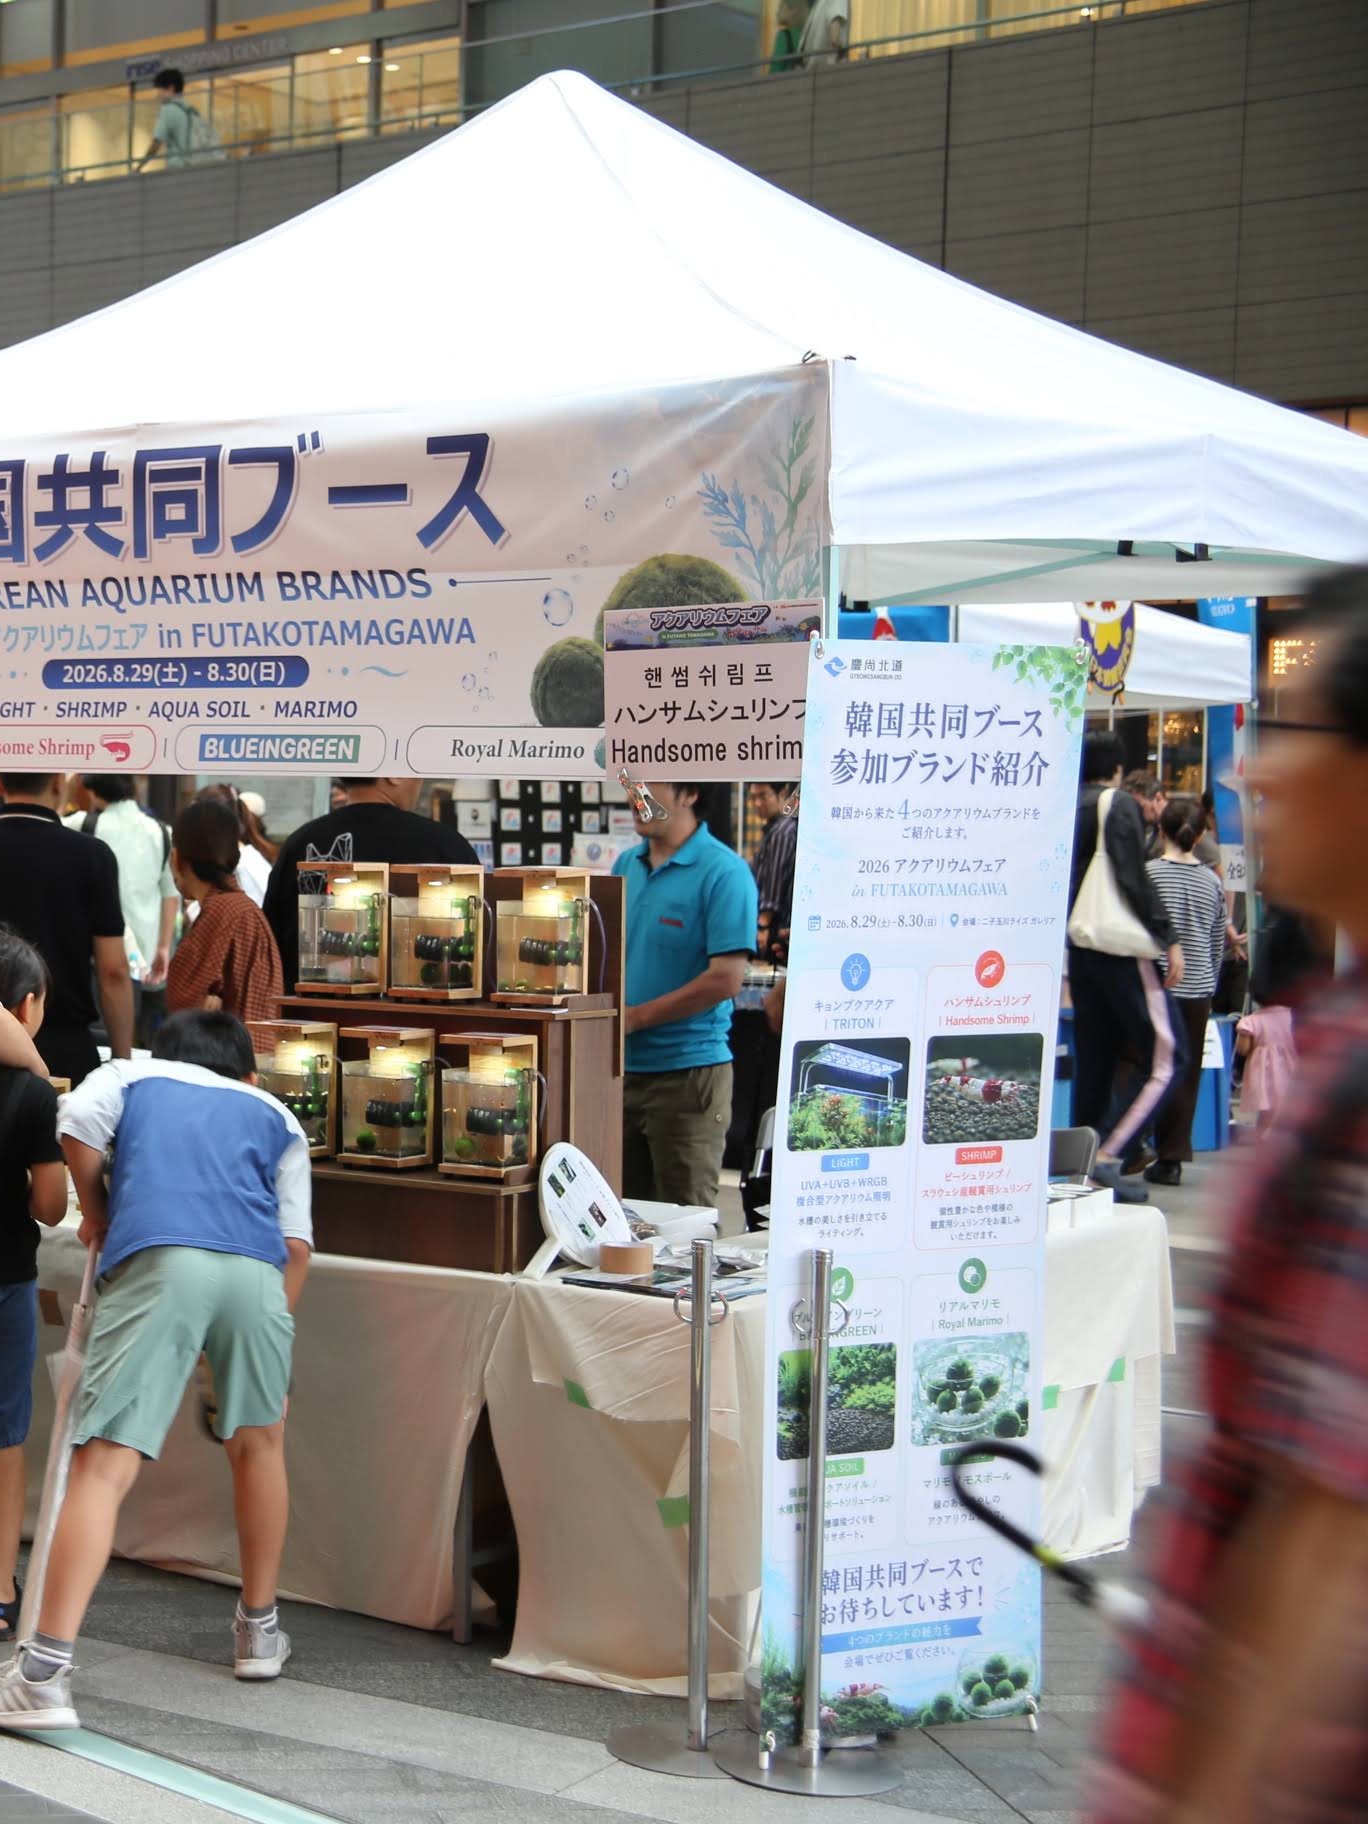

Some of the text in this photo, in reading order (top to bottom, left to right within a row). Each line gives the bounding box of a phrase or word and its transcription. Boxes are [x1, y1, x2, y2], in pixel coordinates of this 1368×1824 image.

[81, 571, 265, 614] AQUARIUM
[276, 568, 433, 601] BRANDS
[650, 605, 770, 630] アクアリウムフェア
[158, 623, 182, 648] in
[191, 617, 476, 648] FUTAKOTAMAGAWA
[62, 662, 187, 686] 2026.8.29(土)
[207, 661, 286, 685] 8.30(日)
[55, 701, 127, 718] SHRIMP
[148, 701, 200, 722] AQUA
[206, 700, 251, 718] SOIL
[274, 700, 358, 718] MARIMO
[844, 700, 1043, 739] 韓国共同ブース
[38, 736, 96, 760] Shrimp
[203, 737, 355, 760] BLUEINGREEN
[450, 738, 585, 763] Royal Marimo
[612, 734, 802, 764] Handsome shrim
[830, 748, 1050, 786] 参加ブランド紹介
[901, 826, 969, 840] ご紹介します。
[858, 858, 1007, 874] 2026 アクアリウムフェア
[851, 883, 1009, 898] in FUTAKOTAMAGAWA
[943, 994, 1032, 1007] ハンサムシュリンプ
[832, 1017, 875, 1030] TRITON
[945, 1014, 1030, 1026] Handsome Shrimp
[831, 1157, 860, 1168] LIGHT
[961, 1149, 998, 1160] SHRIMP
[938, 1318, 965, 1331] Royal
[822, 1556, 984, 1596] 韓国共同ブースで
